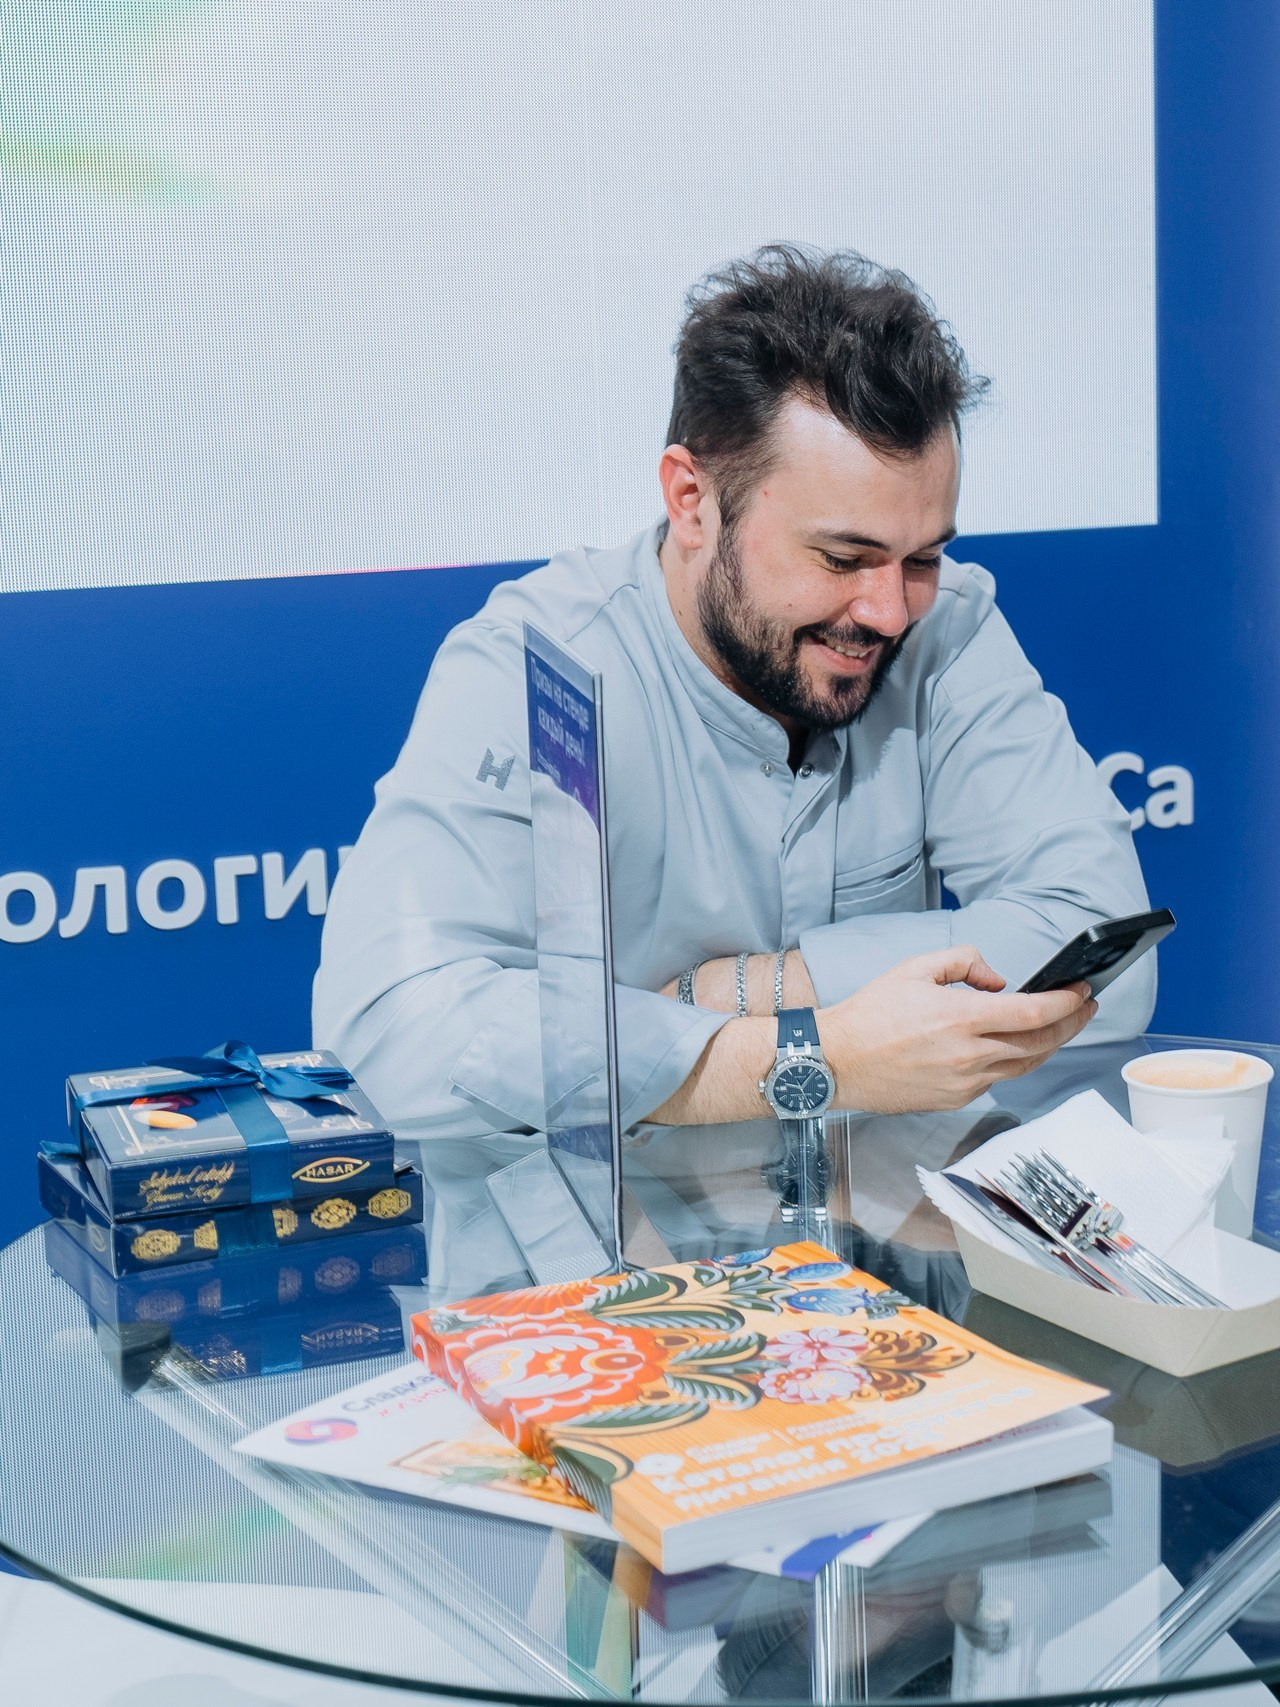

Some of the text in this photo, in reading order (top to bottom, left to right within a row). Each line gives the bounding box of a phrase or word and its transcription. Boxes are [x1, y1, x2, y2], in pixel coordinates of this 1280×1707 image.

[0, 844, 356, 943] ологи
[341, 1371, 437, 1412] Сладка
[651, 1444, 816, 1495] Каталог
[824, 1388, 1033, 1453] продуктов
[673, 1458, 848, 1511] питания
